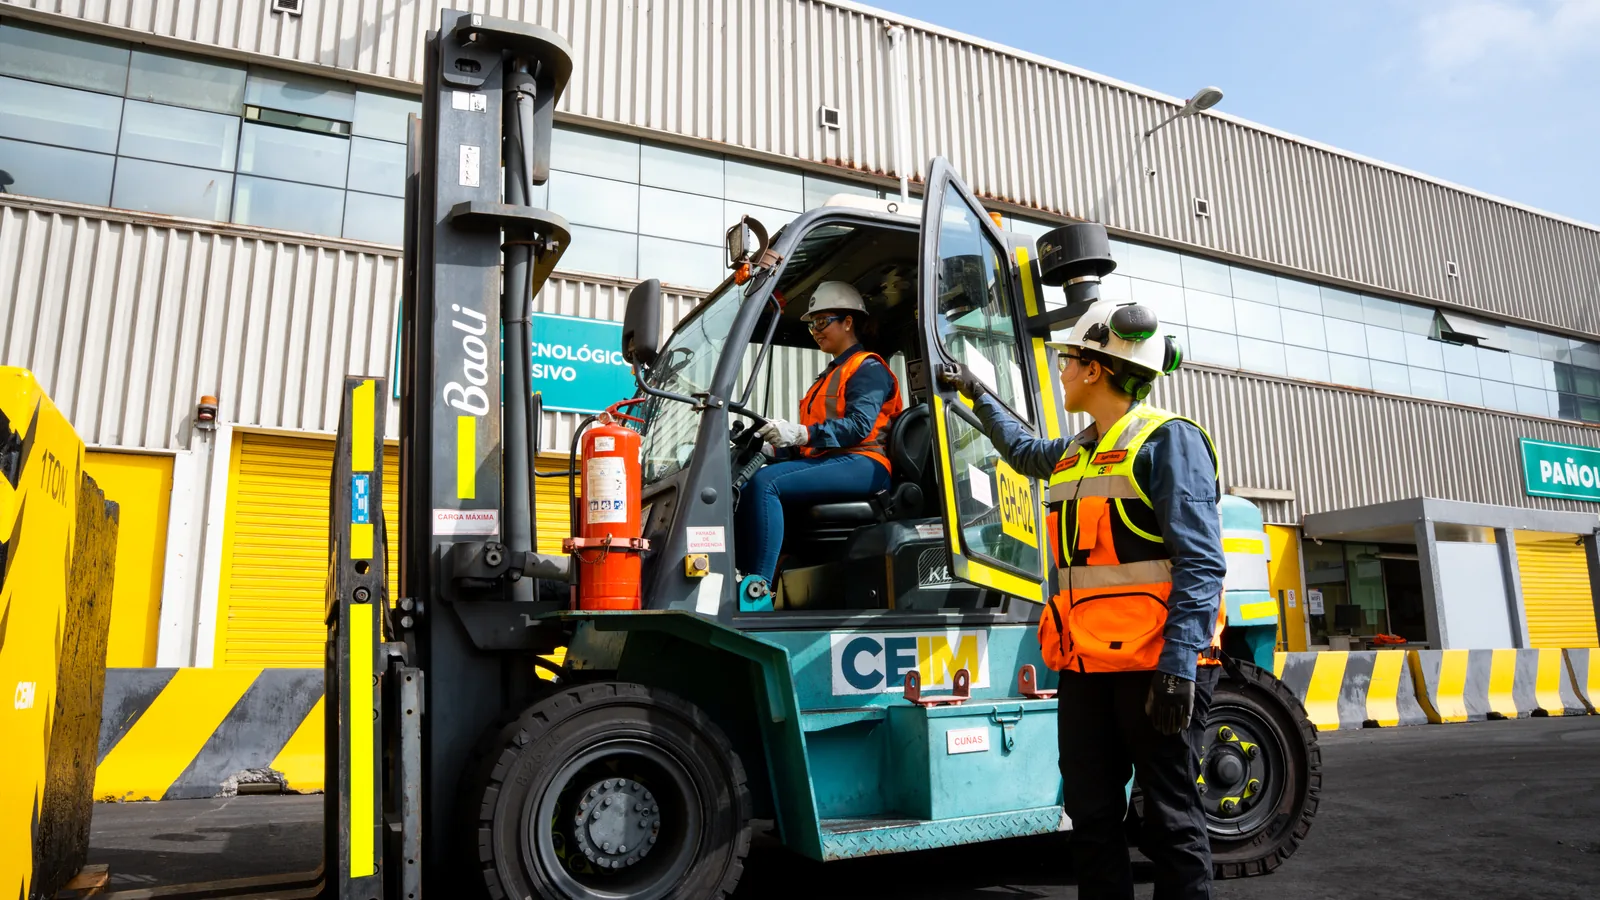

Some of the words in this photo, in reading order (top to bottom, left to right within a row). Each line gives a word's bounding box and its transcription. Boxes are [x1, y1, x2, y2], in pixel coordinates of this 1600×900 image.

[443, 303, 490, 416] Baoli
[1540, 457, 1600, 489] PAÑOL
[437, 513, 464, 521] CARGA
[465, 511, 495, 521] MÁXIMA
[1000, 472, 1034, 535] GH-02
[841, 634, 980, 691] CEIM
[954, 734, 983, 746] CUÑAS
